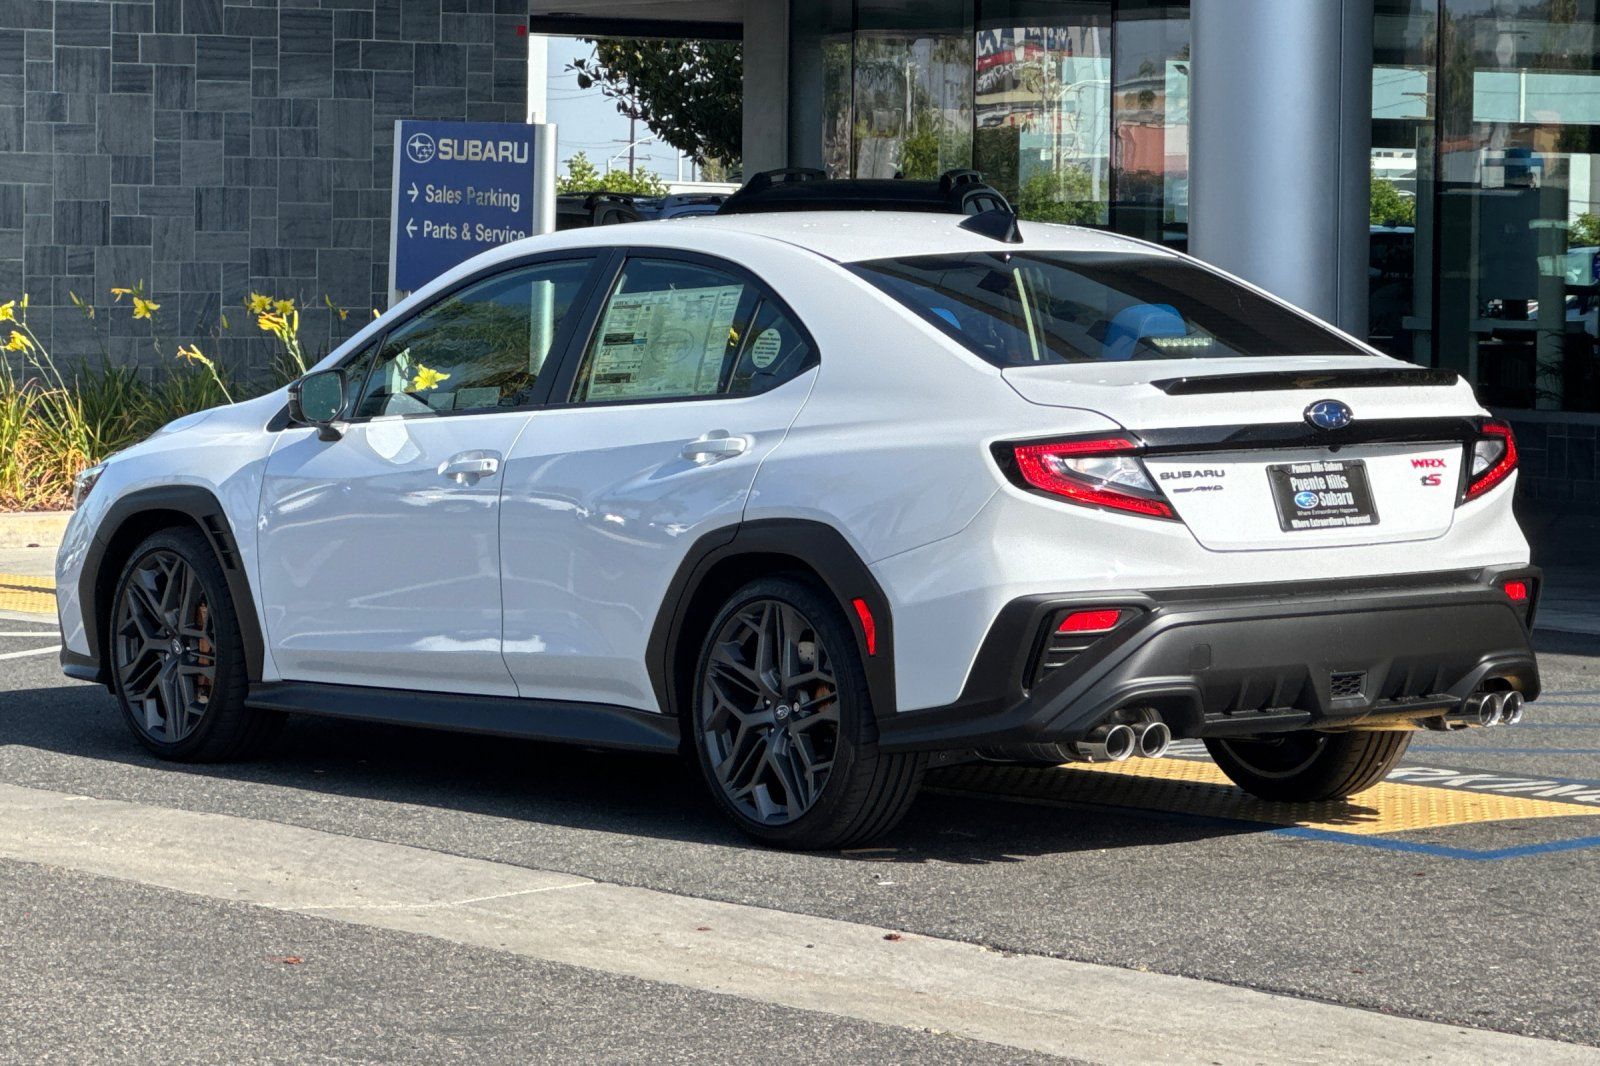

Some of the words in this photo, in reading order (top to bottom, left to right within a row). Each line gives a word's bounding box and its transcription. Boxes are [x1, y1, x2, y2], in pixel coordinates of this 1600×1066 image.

[438, 138, 528, 164] SUBARU
[425, 184, 462, 205] Sales
[467, 186, 520, 213] Parking
[423, 220, 457, 240] Parts
[461, 222, 471, 241] &
[475, 223, 526, 243] Service
[1291, 464, 1311, 474] Puente
[1311, 463, 1324, 472] Hills
[1324, 462, 1344, 472] Subaru
[1410, 458, 1447, 469] WRX
[1160, 469, 1226, 480] SUBARU
[1290, 475, 1327, 492] Puente
[1325, 474, 1349, 489] Hills
[1319, 491, 1354, 507] Subaru
